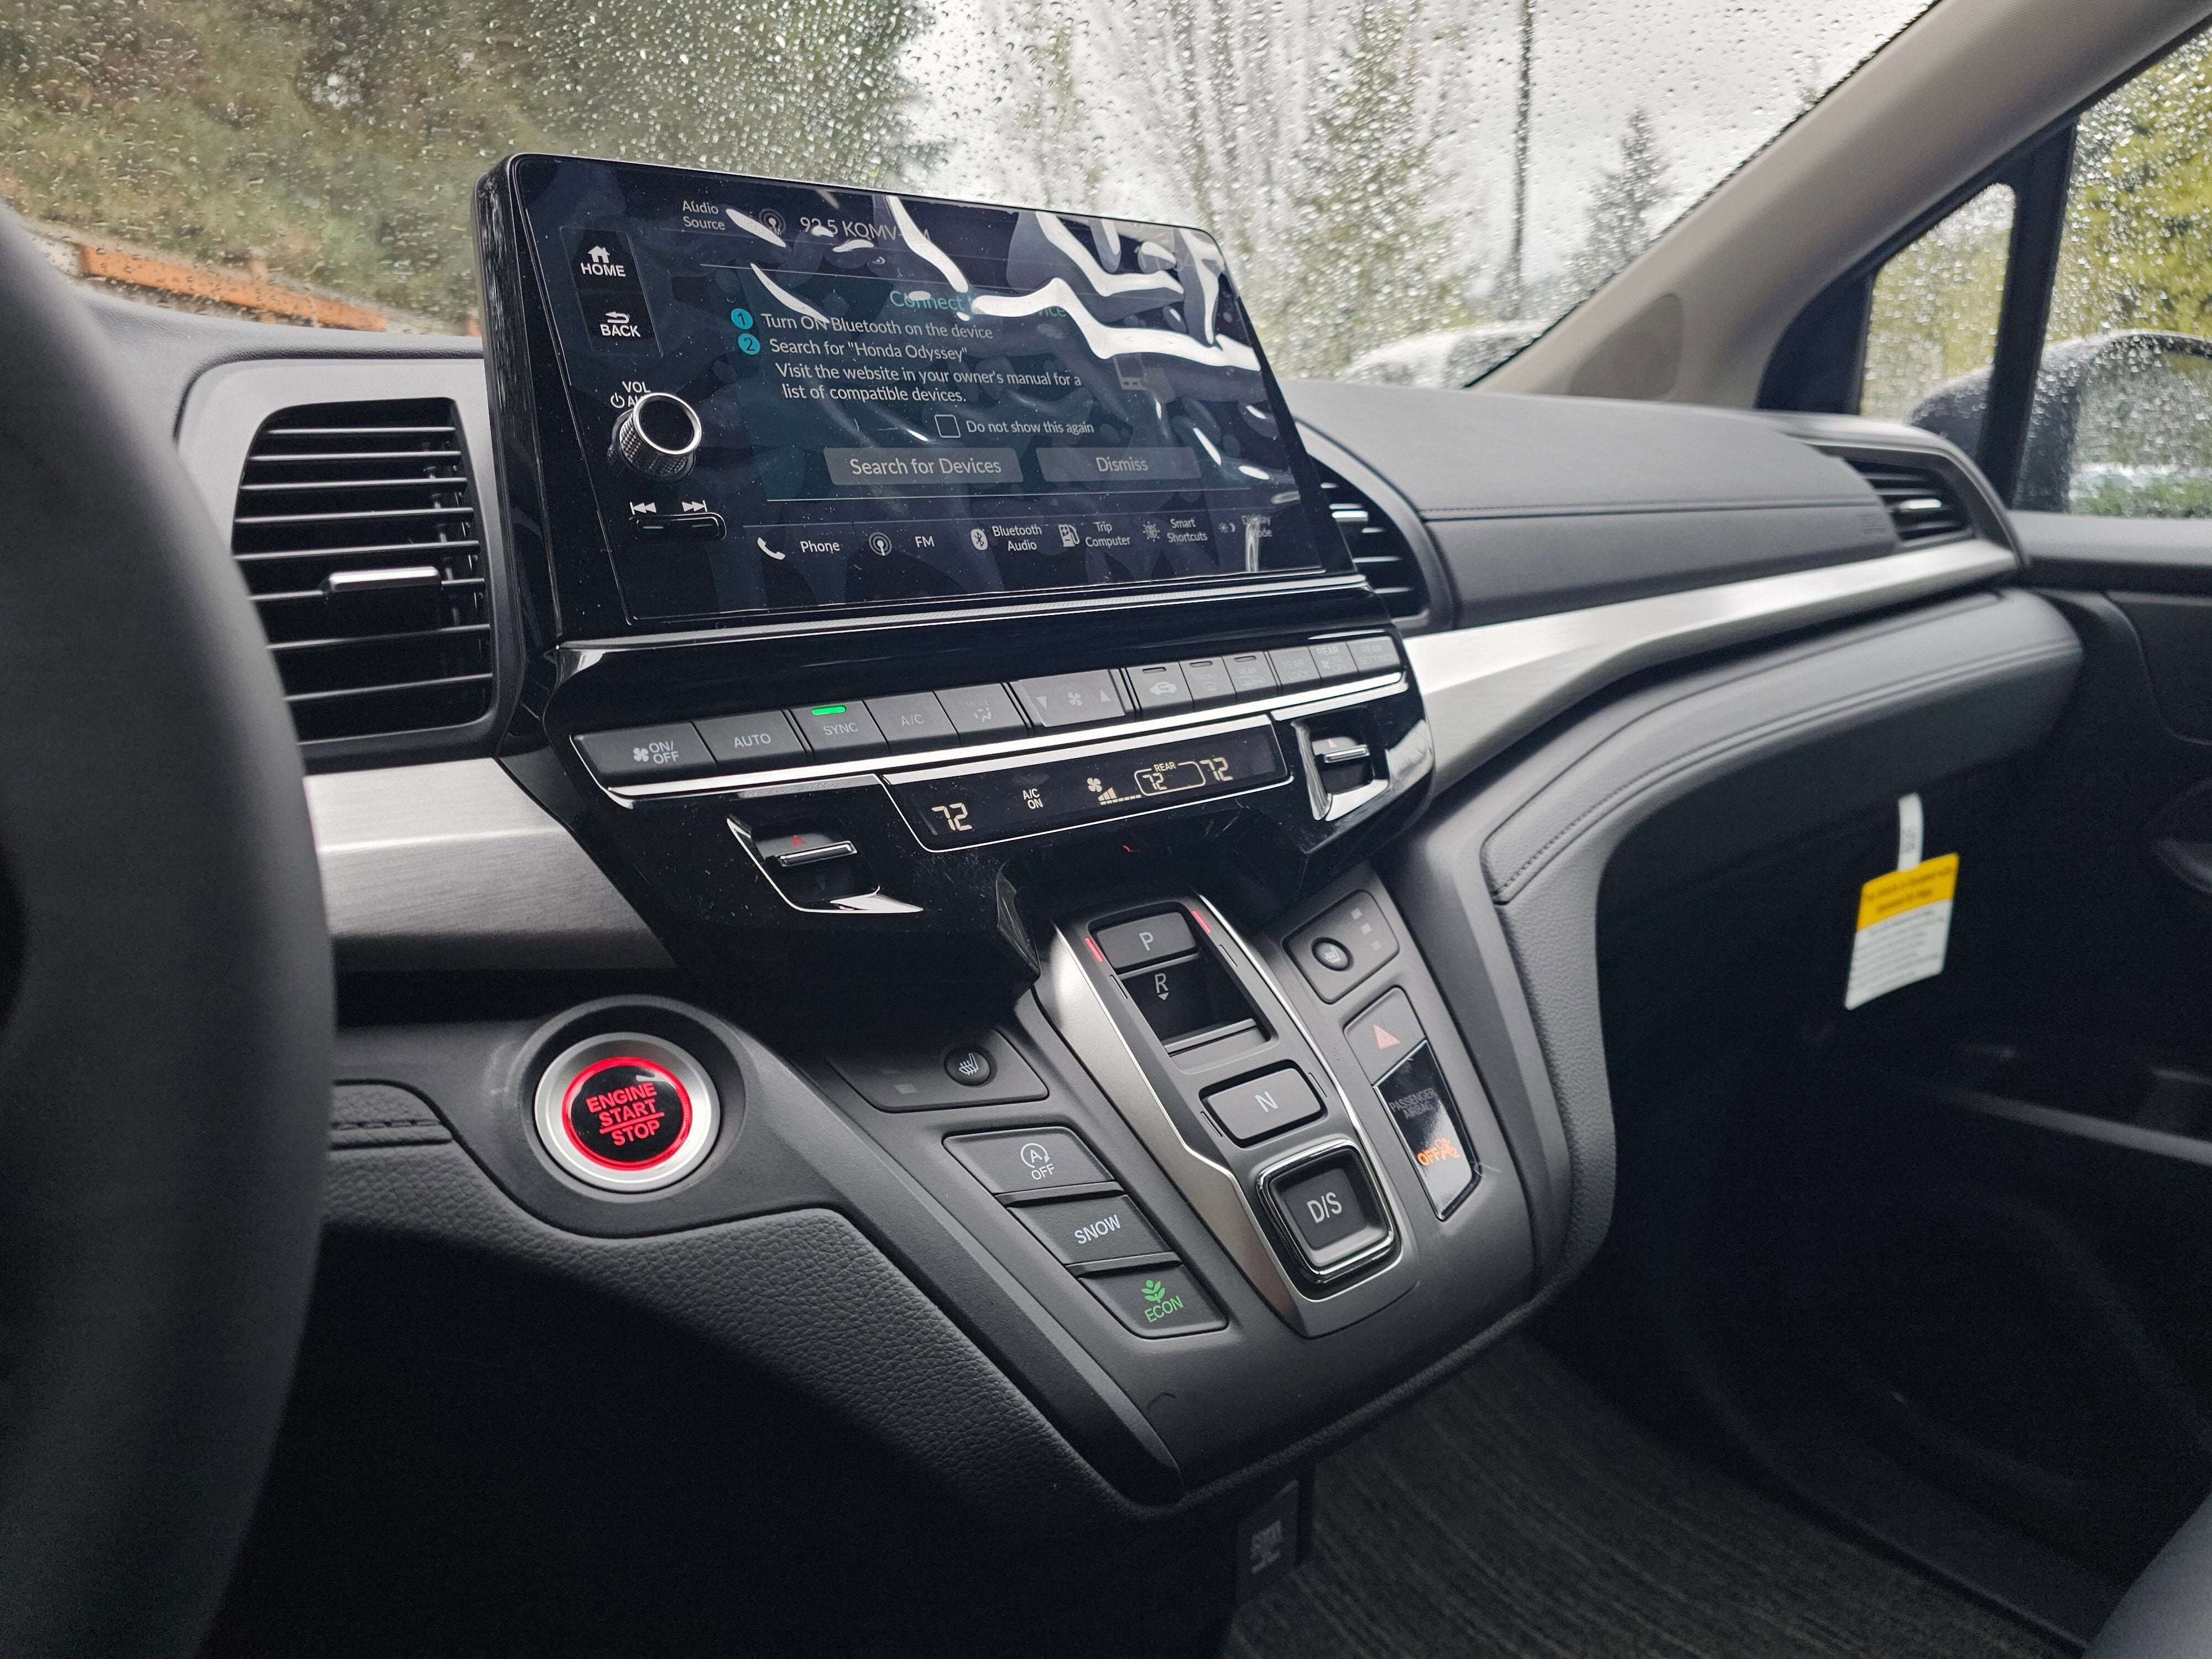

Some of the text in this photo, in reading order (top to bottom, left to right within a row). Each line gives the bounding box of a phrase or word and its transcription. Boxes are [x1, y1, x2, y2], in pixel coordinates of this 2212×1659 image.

[682, 200, 719, 215] Audio
[684, 216, 725, 231] Source
[581, 263, 626, 277] HOME
[600, 324, 641, 337] BACK
[737, 313, 994, 339] 1 Turn ON Bluetooth on the device
[744, 337, 968, 363] 2 Search for "Honda Odyssey"
[775, 362, 1082, 386] Visit the website in your owner's manual for a
[622, 381, 651, 393] VOL
[782, 383, 967, 403] list of compatible devices.
[966, 420, 1094, 435] Do not show this again
[849, 457, 1001, 476] Search for Devices
[1095, 456, 1149, 472] Dismiss
[992, 524, 1042, 537] Bluetooth
[1093, 521, 1113, 535] Trip
[1170, 518, 1196, 529] Smart
[915, 535, 935, 548] FM
[1085, 535, 1131, 549] Computer
[1167, 531, 1208, 544] Shortcuts
[800, 541, 841, 554] Phone
[1007, 539, 1037, 552] Audio
[1317, 646, 1340, 656] REAR
[1361, 644, 1383, 654] REAR
[1281, 659, 1305, 670] REAR
[1286, 670, 1311, 681] LOCK
[901, 713, 925, 727] A/C
[823, 722, 858, 736] SYNC
[649, 740, 674, 753] ON/
[734, 733, 771, 749] AUTO
[653, 750, 680, 764] OFF
[1154, 761, 1177, 773] REAR
[1199, 757, 1234, 781] 72
[1142, 773, 1167, 791] 72
[1022, 788, 1040, 800] A/C
[1027, 798, 1044, 810] ON
[931, 802, 973, 832] 72
[1139, 931, 1154, 951] P
[1154, 973, 1168, 993] R
[586, 1082, 657, 1113] ENGINE
[1254, 1091, 1279, 1113] N
[1389, 1088, 1437, 1113] PASSENGER
[598, 1098, 657, 1127] START
[1403, 1100, 1434, 1120] AIRBAG
[611, 1120, 660, 1146] STOP
[1417, 1147, 1439, 1166] OFF
[1031, 1164, 1055, 1180] OFF
[1307, 1192, 1343, 1223] D/S
[1074, 1214, 1121, 1244] SNOW
[1144, 1295, 1184, 1323] ECON
